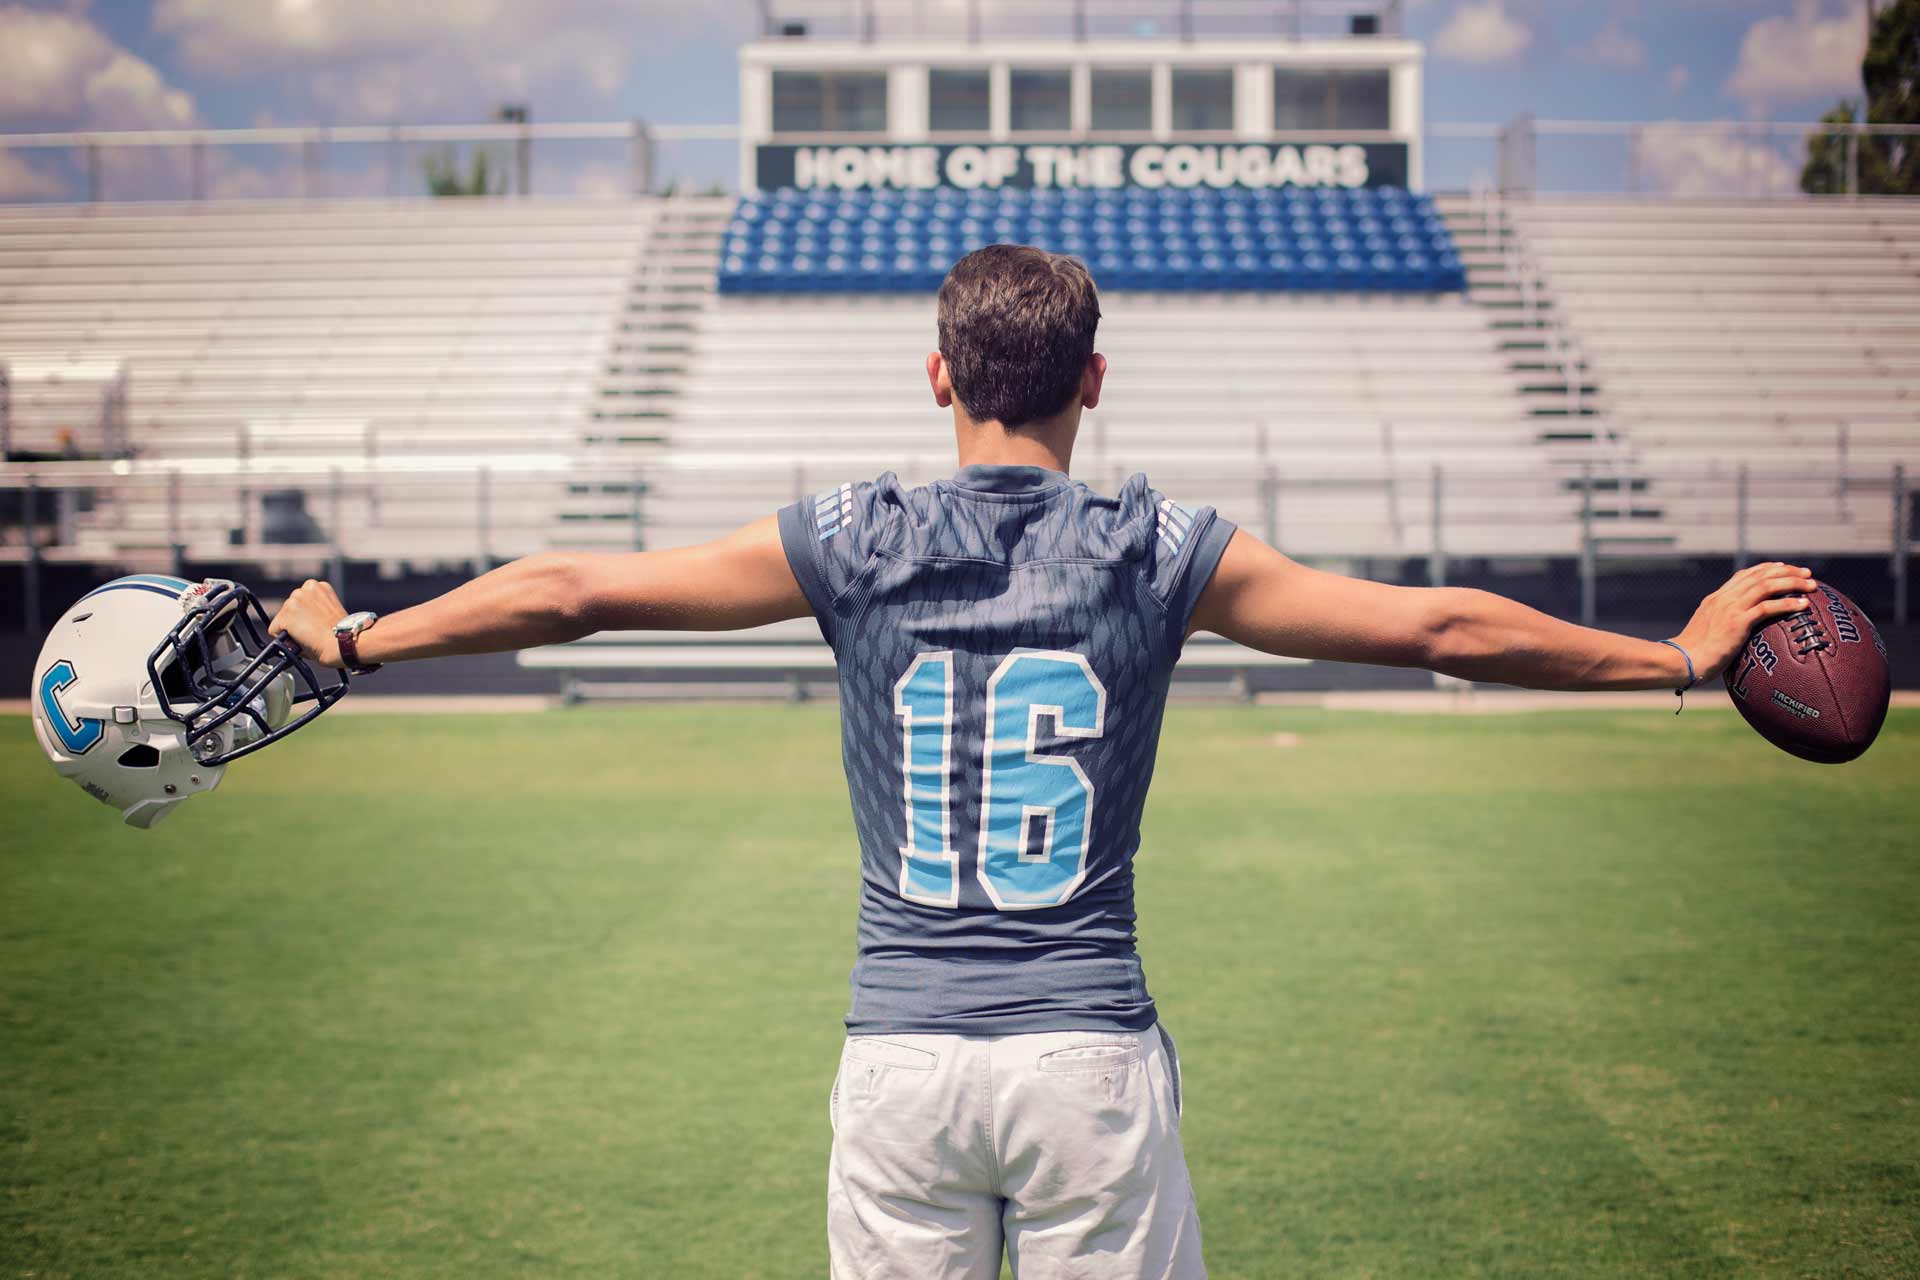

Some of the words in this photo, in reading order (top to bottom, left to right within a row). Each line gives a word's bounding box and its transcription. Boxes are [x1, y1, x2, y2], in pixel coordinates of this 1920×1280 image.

[794, 145, 941, 191] HOME
[945, 145, 1021, 191] OF
[1025, 145, 1125, 190] THE
[1129, 144, 1370, 190] COUGARS
[1773, 689, 1821, 719] TACKIFIED
[893, 646, 1107, 912] 16
